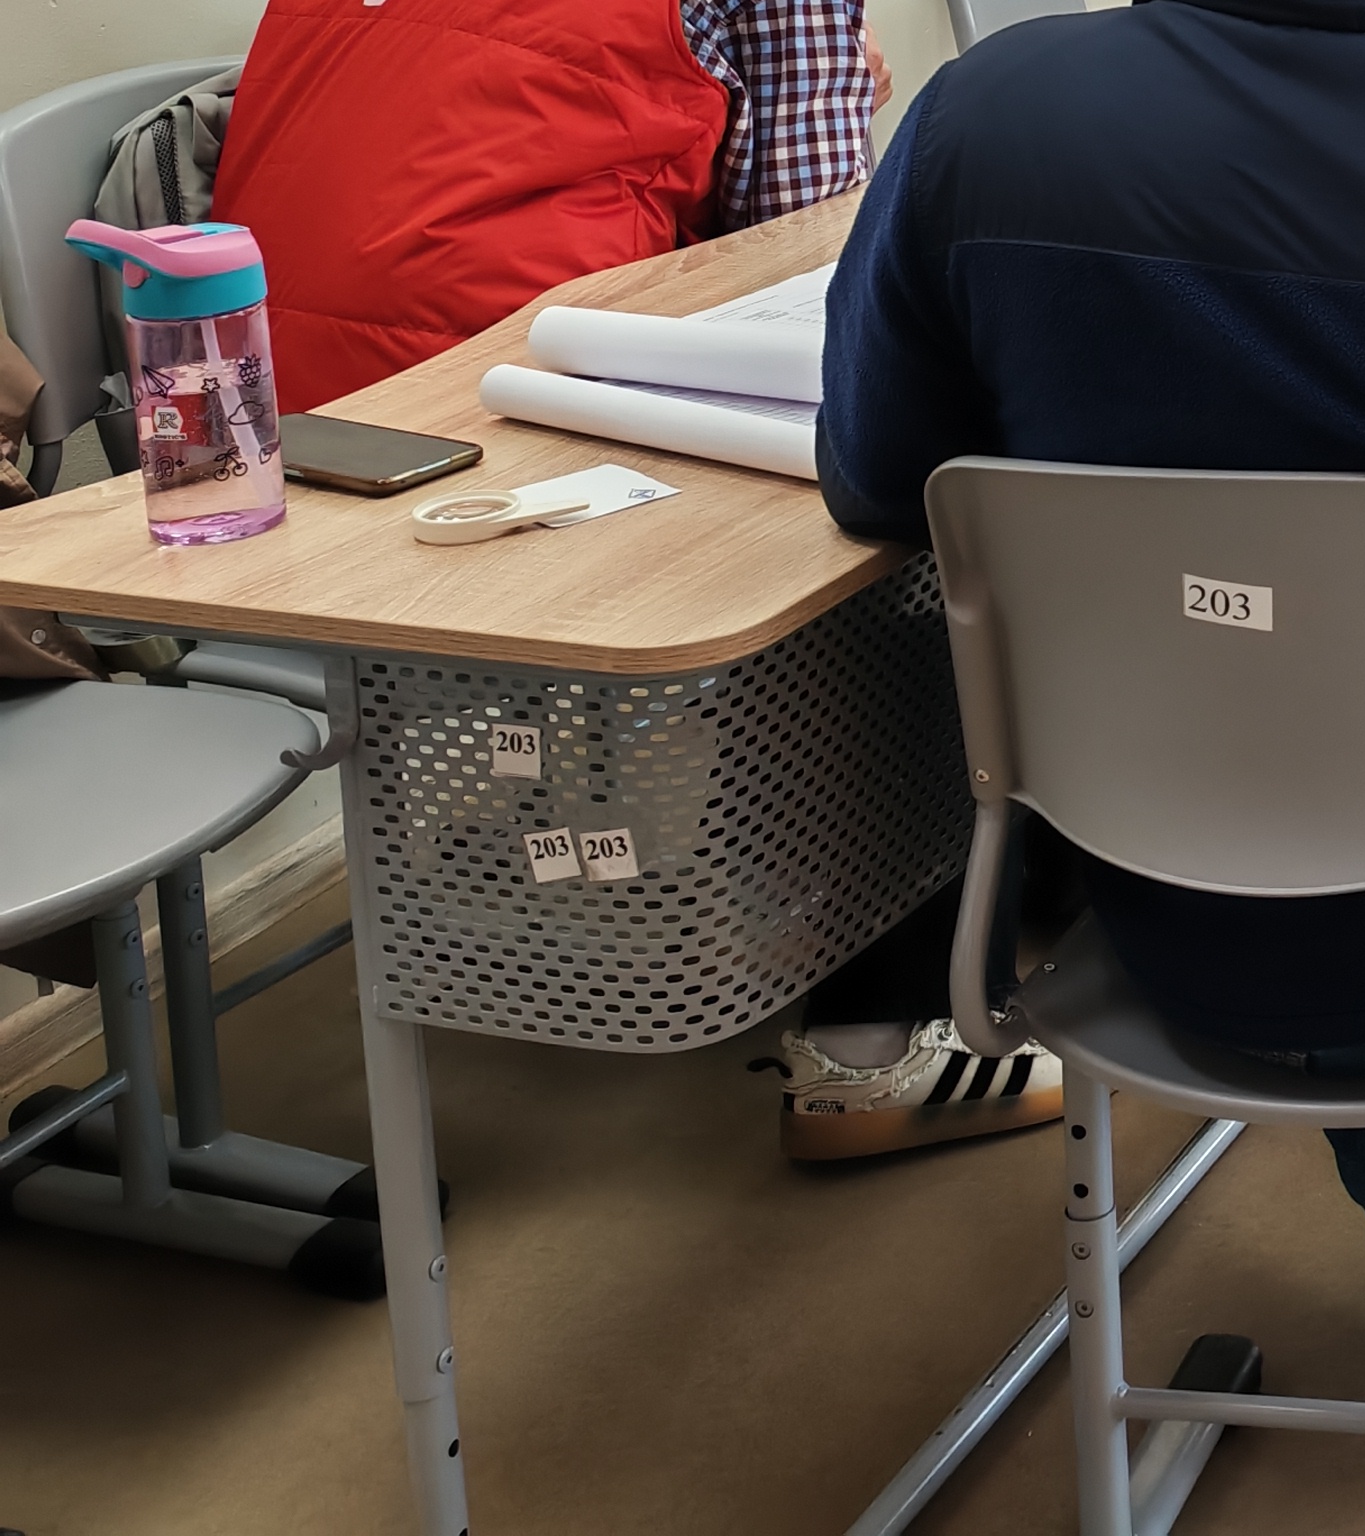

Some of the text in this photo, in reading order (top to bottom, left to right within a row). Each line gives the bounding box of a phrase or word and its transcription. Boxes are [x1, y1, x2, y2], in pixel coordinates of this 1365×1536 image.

[1188, 584, 1251, 621] 203
[495, 731, 536, 755] 203
[530, 835, 569, 860] 203
[585, 836, 629, 861] 203
